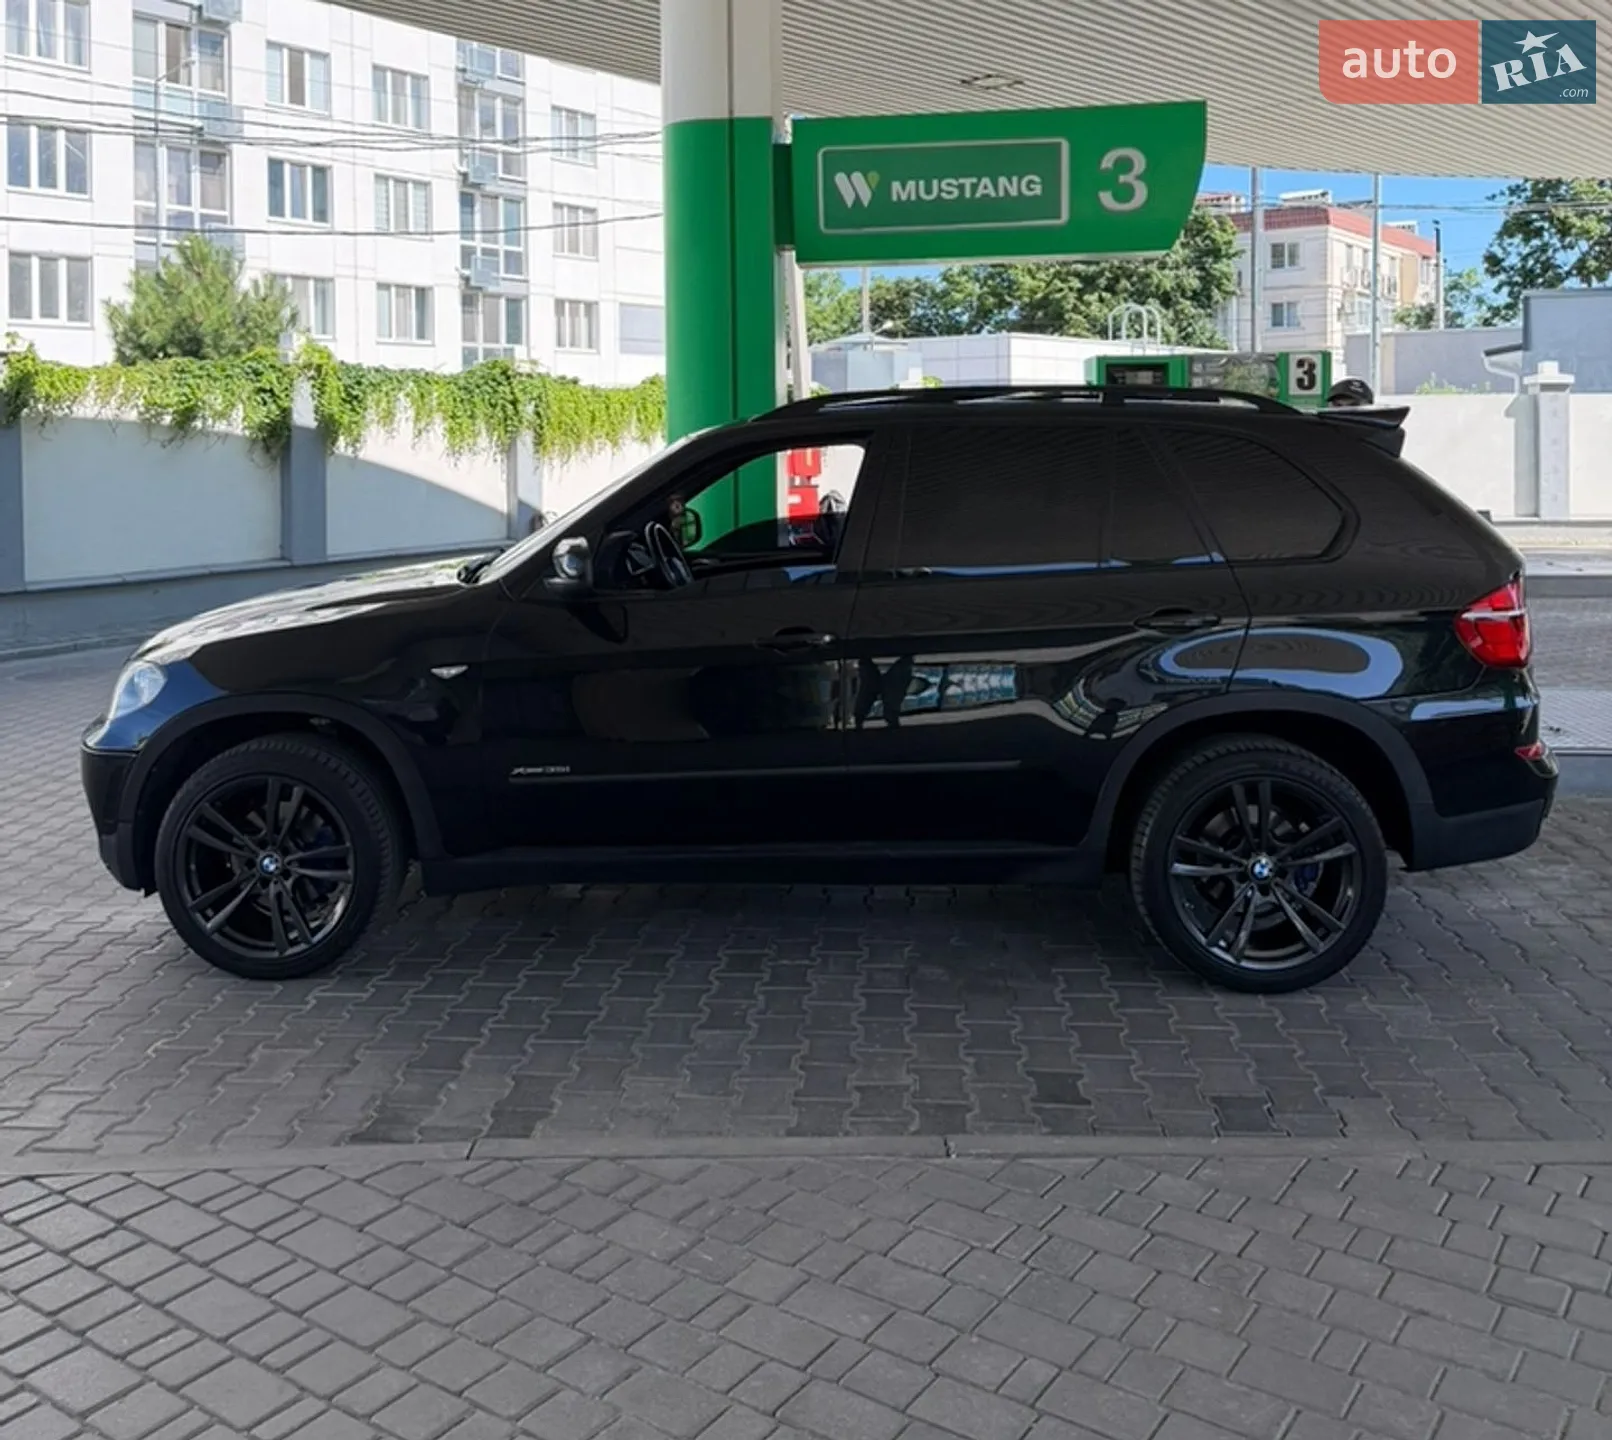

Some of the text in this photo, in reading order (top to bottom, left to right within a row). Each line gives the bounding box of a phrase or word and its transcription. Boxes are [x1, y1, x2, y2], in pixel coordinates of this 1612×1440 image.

[891, 174, 1043, 203] MUSTANG
[1097, 147, 1149, 213] 3
[1296, 358, 1317, 391] 3
